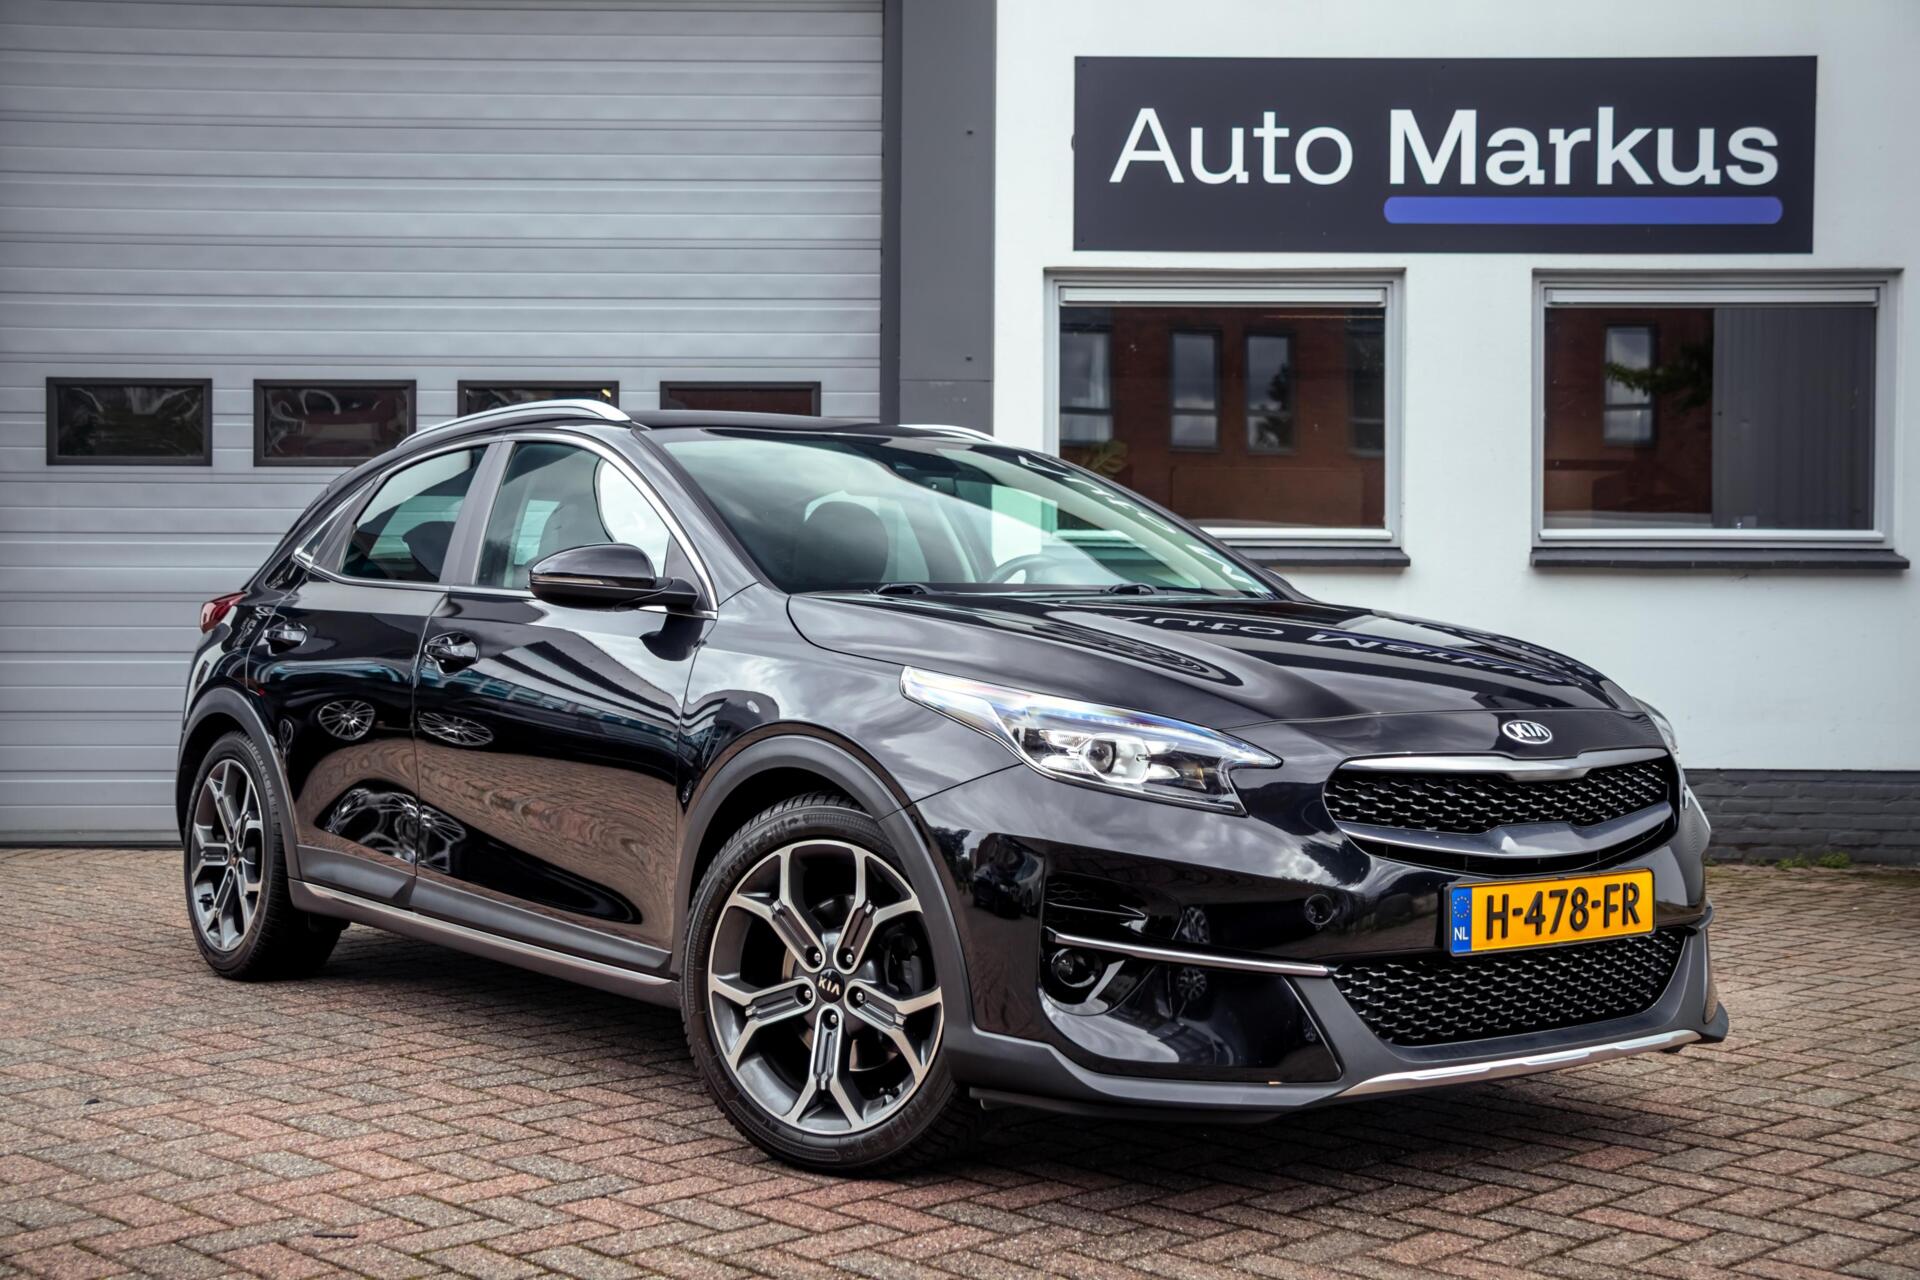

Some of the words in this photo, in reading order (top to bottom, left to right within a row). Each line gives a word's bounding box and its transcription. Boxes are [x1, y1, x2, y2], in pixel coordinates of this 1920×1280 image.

[1108, 107, 1354, 185] Auto
[1389, 106, 1779, 186] Markus
[1508, 722, 1549, 739] KIA
[1486, 881, 1641, 941] H-478-FR
[1454, 926, 1470, 942] NL
[818, 975, 841, 996] KIA
